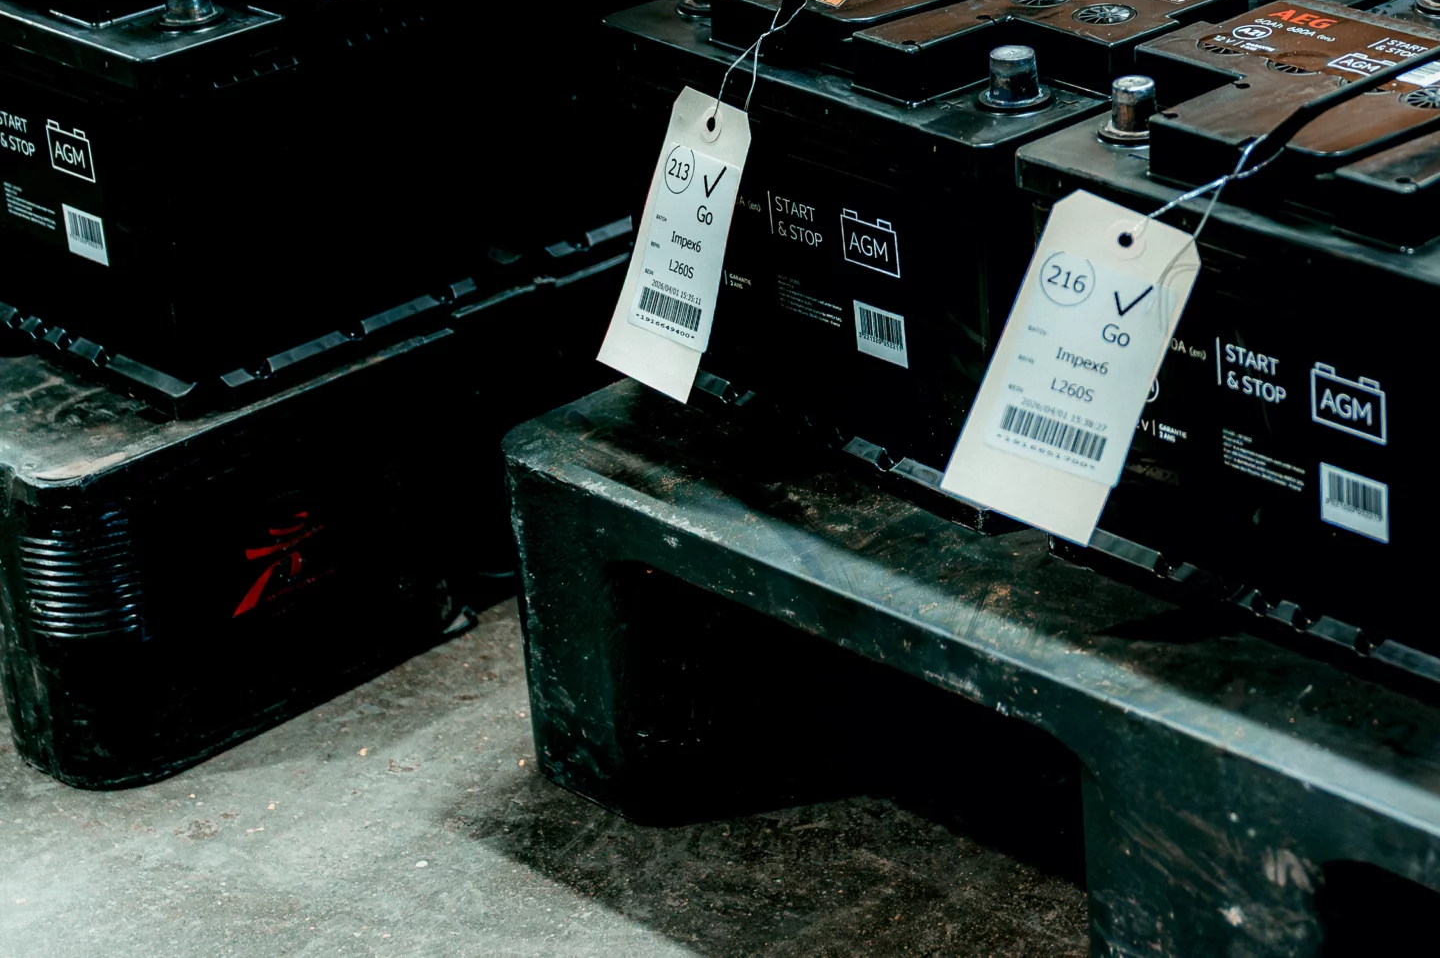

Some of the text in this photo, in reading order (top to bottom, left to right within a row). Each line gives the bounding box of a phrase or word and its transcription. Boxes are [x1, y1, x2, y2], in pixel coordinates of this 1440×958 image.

[1254, 18, 1284, 30] 60Ah
[1268, 9, 1338, 30] AEG
[1386, 39, 1429, 54] START
[1339, 57, 1382, 72] AGM
[9, 135, 35, 157] STOP
[55, 140, 86, 169] AGM
[668, 158, 691, 182] 213
[696, 205, 714, 226] Go
[775, 196, 815, 222] START
[671, 230, 702, 253] Impex6
[778, 220, 823, 248] & STOP
[849, 232, 889, 262] AGM
[668, 258, 695, 280] L260S
[1047, 263, 1087, 294] 216
[1101, 323, 1131, 348] Go
[1055, 346, 1110, 375] Impex6
[1225, 343, 1279, 377] START
[1051, 377, 1095, 403] L260S
[1227, 371, 1287, 404] & STOP
[1320, 388, 1373, 426] AGM
